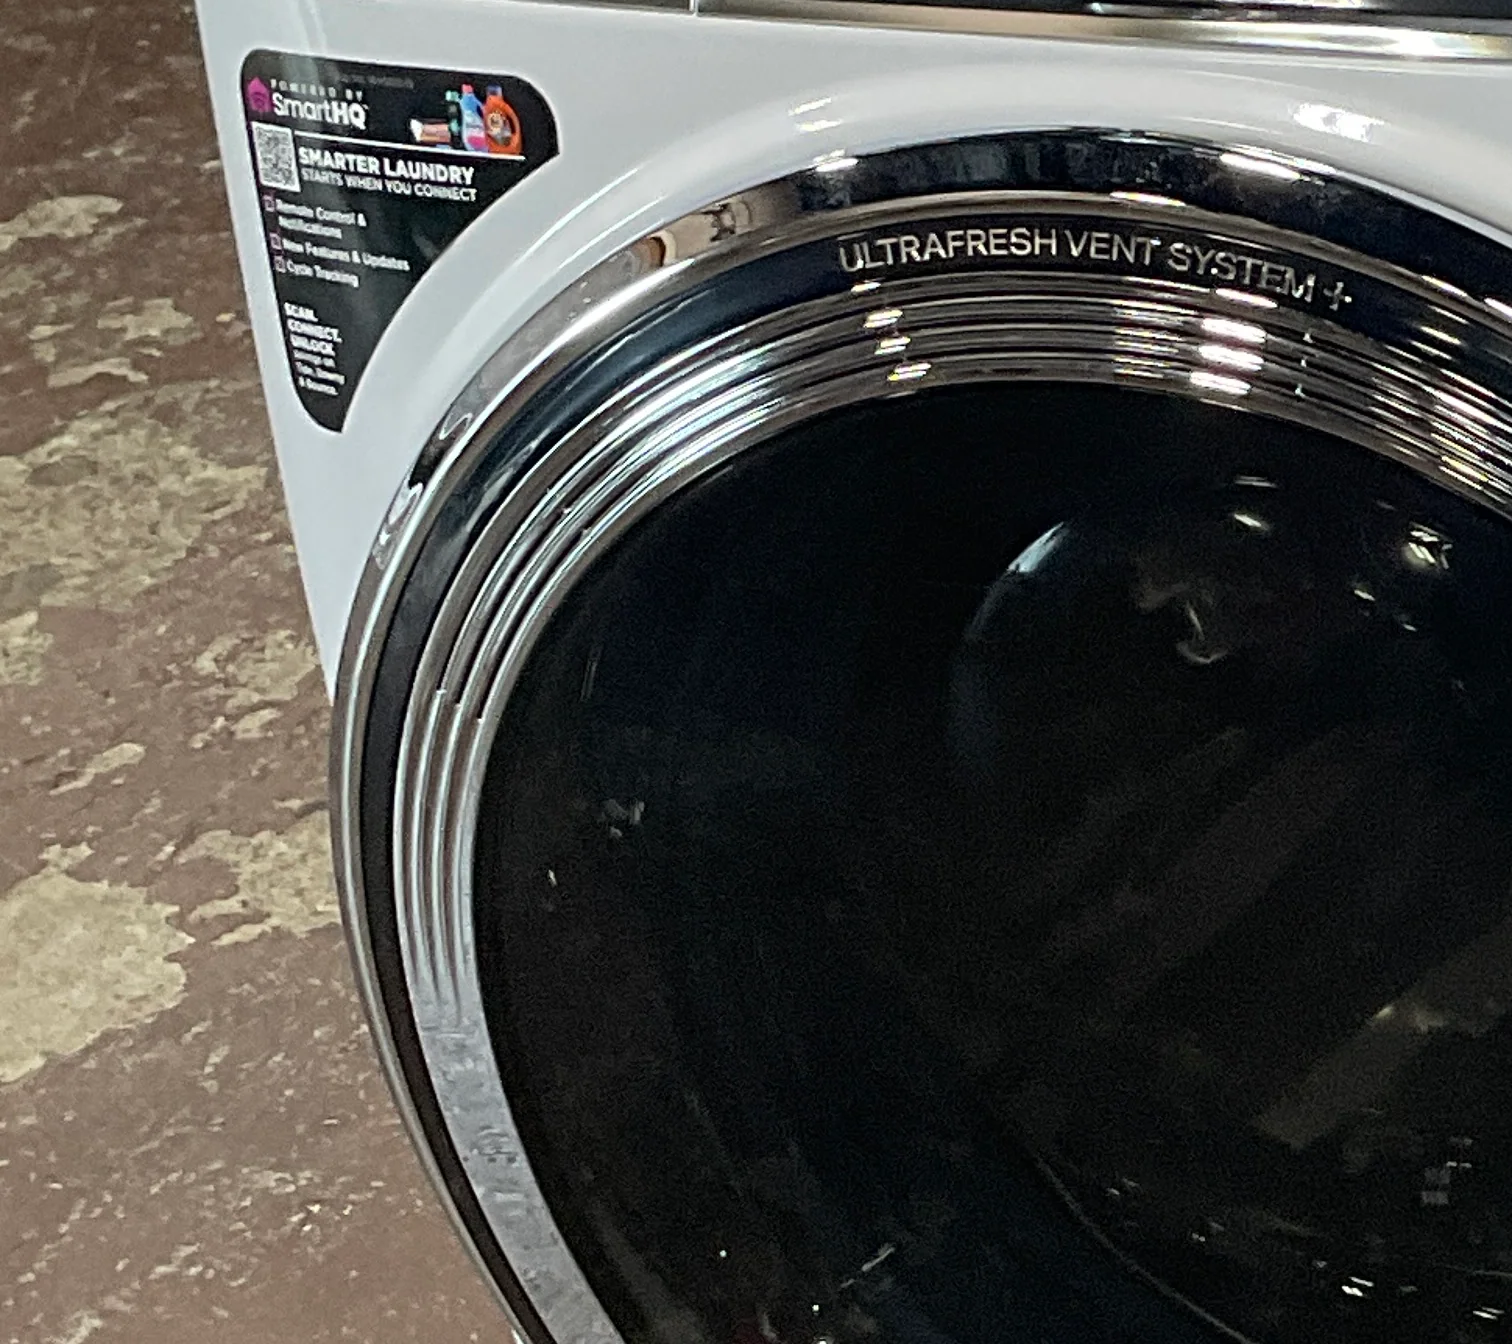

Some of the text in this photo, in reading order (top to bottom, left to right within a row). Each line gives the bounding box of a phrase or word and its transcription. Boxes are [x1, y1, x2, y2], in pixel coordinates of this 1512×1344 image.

[299, 146, 476, 187] SMARTER LAUNDRY
[300, 167, 479, 204] STARTS WHEN YOU CONNECT
[837, 226, 1058, 274] ULTRAFRESH
[1063, 228, 1155, 268] VENT
[1166, 241, 1318, 303] SYSTEM
